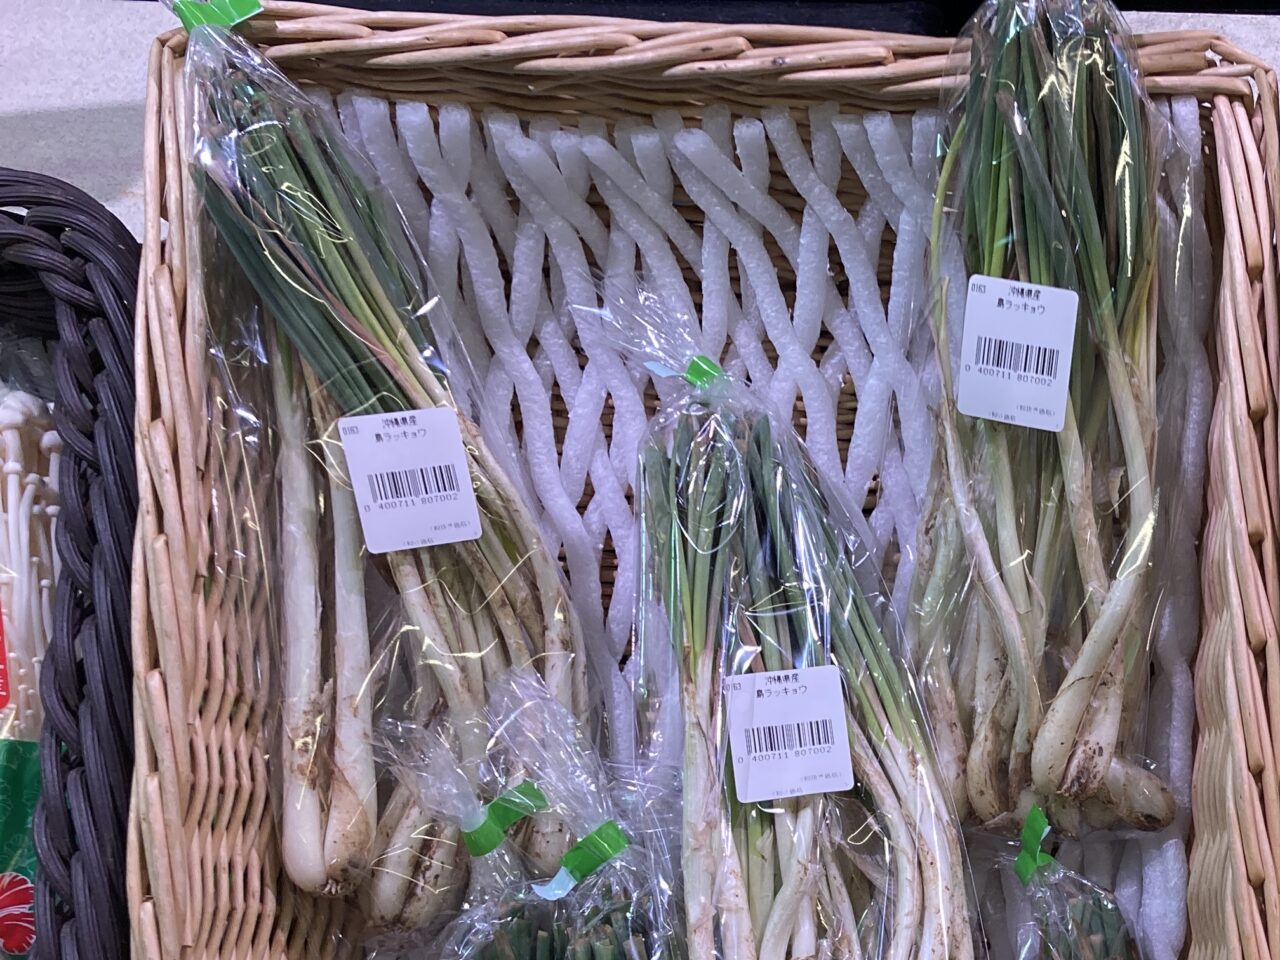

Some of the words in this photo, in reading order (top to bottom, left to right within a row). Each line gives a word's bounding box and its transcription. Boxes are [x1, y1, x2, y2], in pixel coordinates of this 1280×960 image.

[971, 283, 987, 294] 0163
[1008, 285, 1041, 300] 沖縄県産
[997, 298, 1045, 315] 島ラッキョウ
[978, 368, 1011, 380] 400711
[1017, 374, 1052, 386] 807002
[382, 416, 417, 429] 沖縄県産
[378, 500, 415, 510] 400711
[421, 493, 458, 505] 807002
[766, 673, 799, 685] 沖縄県産
[757, 685, 807, 698] 島ラッキョウ
[752, 752, 788, 761] 400711
[795, 746, 832, 757] 807002
